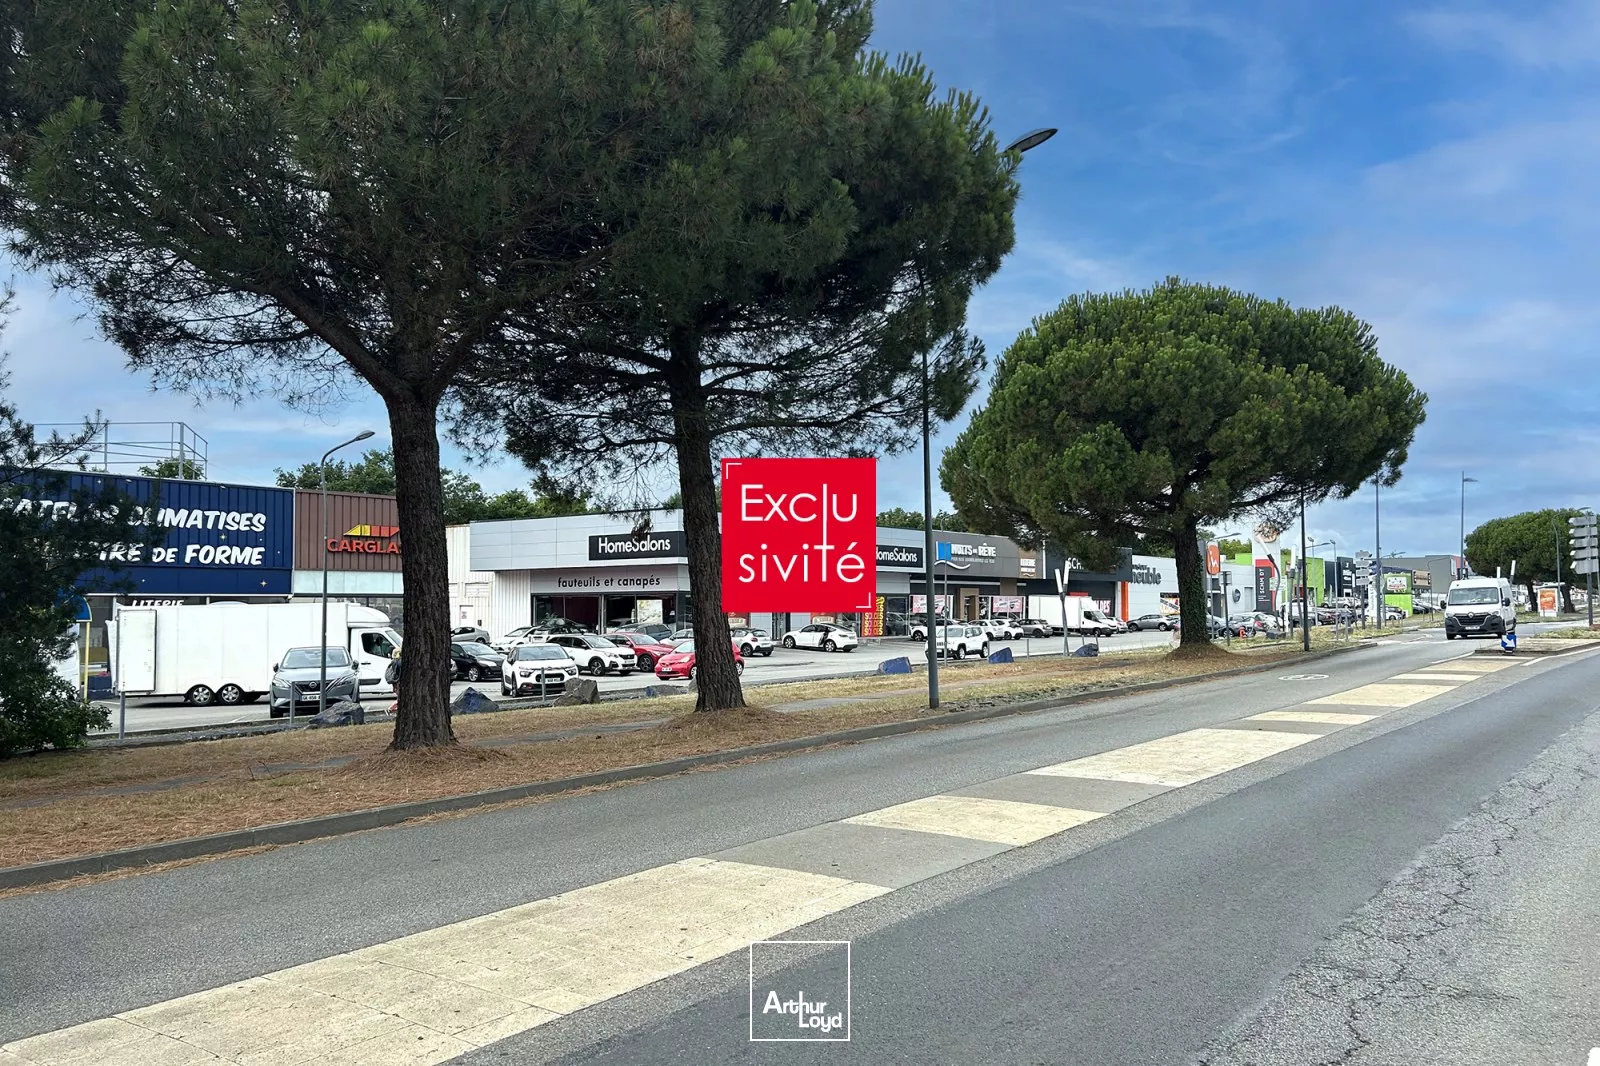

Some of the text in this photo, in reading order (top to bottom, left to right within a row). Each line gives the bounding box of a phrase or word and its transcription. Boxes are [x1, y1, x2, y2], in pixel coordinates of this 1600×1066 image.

[327, 539, 401, 555] CARGLA
[598, 534, 671, 554] HomeSalons
[151, 547, 179, 563] DE
[184, 544, 266, 565] FORME
[558, 574, 661, 589] fauteuils et canapés
